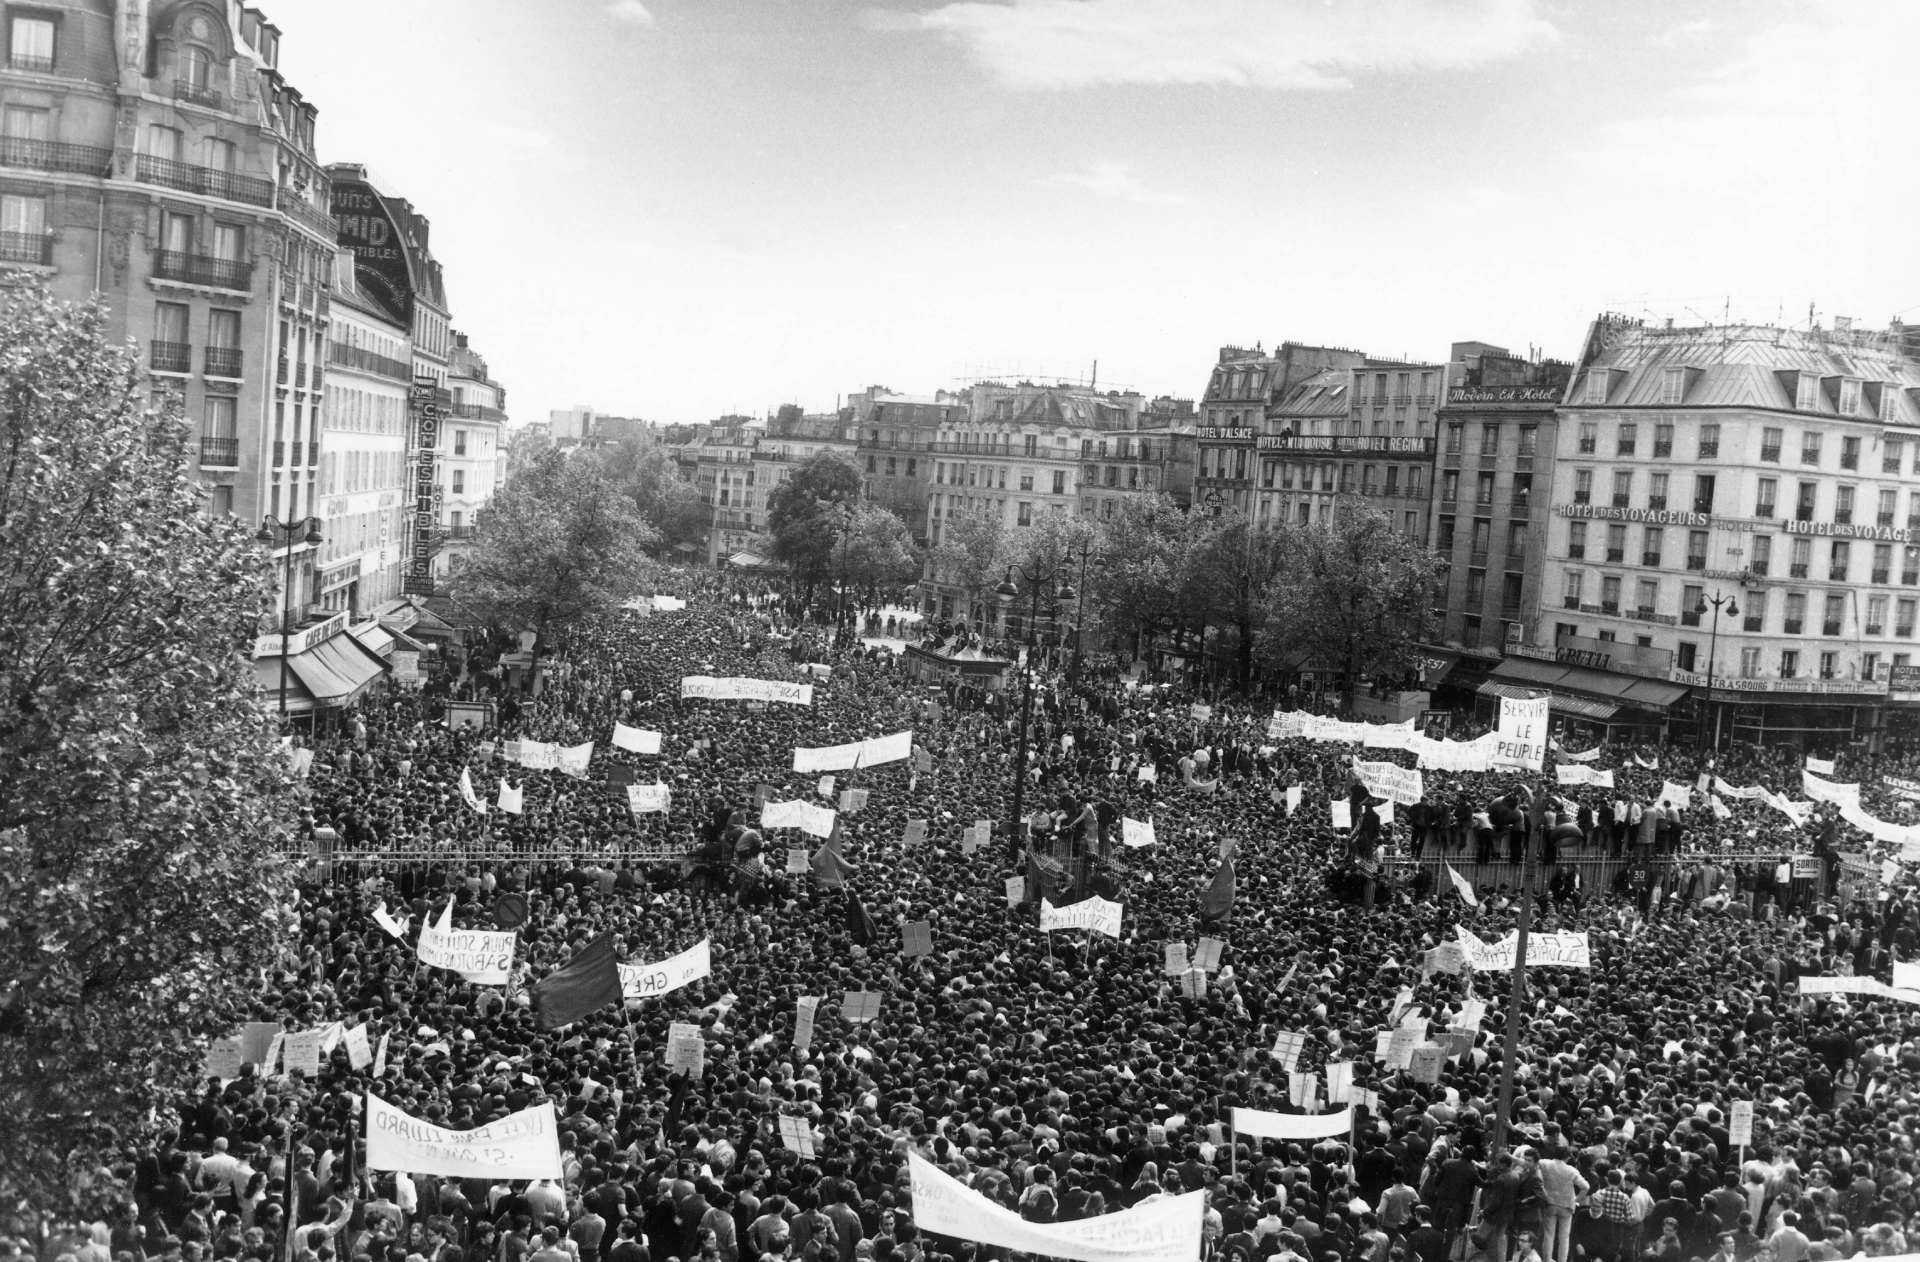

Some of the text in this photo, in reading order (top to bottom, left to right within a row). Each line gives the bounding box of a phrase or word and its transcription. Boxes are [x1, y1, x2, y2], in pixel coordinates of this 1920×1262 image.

[1449, 387, 1494, 401] Modern
[1499, 388, 1515, 400] Est
[1196, 427, 1217, 438] HOTEL
[1257, 437, 1281, 449] HOTEL
[1358, 436, 1425, 451] HOTEL REGINA
[416, 404, 436, 573] COMESTIBLES
[1559, 504, 1708, 526] HOTEL DES VOYAGEURS
[1717, 520, 1757, 532] HOTEL
[1787, 520, 1834, 536] HOTEL
[1835, 525, 1854, 536] DES
[381, 516, 389, 572] HOTEL
[261, 642, 292, 652] d'Alsae
[1894, 666, 1920, 675] HOTEL
[1503, 701, 1546, 717] SERVIR
[1516, 724, 1531, 739] LE
[1498, 740, 1544, 761] PEUPLE
[1796, 859, 1820, 869] SORTIE
[1634, 870, 1645, 879] 30
